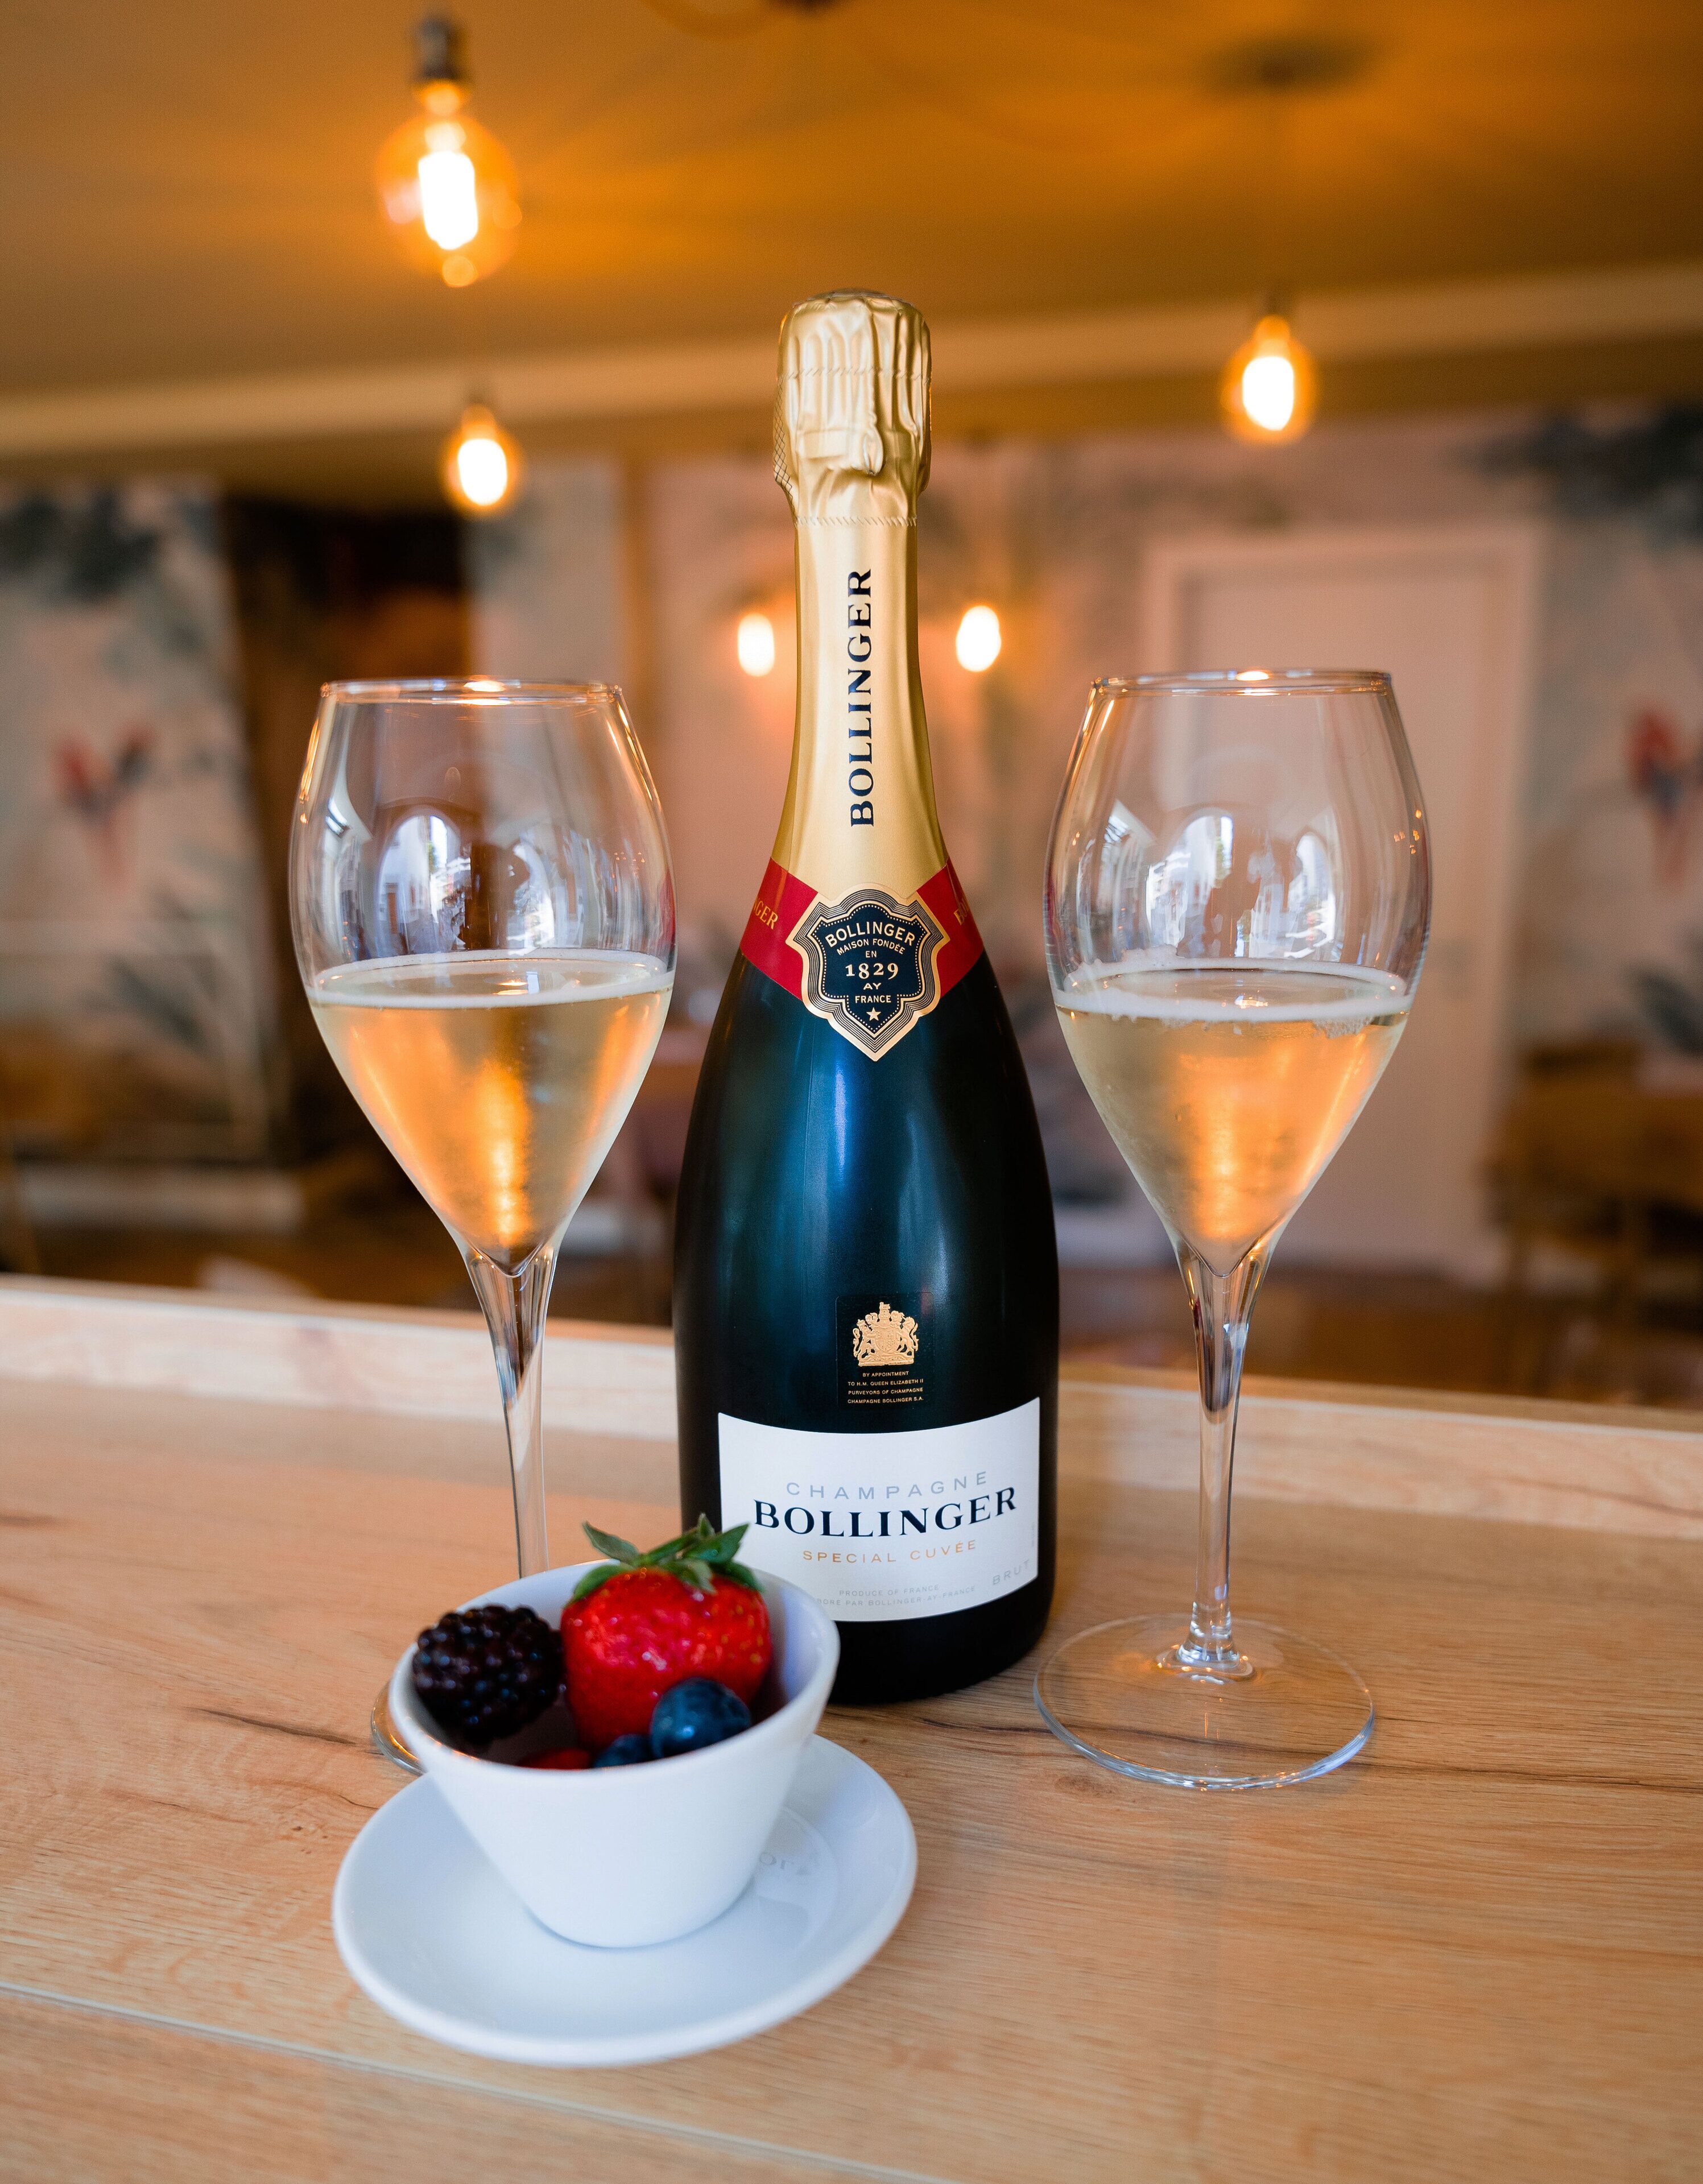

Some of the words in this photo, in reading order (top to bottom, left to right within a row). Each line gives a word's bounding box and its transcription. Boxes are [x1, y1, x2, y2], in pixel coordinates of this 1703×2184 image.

[848, 569, 874, 827] BOLLINGER
[825, 921, 915, 948] BOLLINGER
[837, 938, 869, 956] MAISON
[873, 938, 905, 954] FONDÉE
[845, 963, 899, 980] 1829
[786, 1471, 987, 1500] CHAMPAGNE
[753, 1487, 1017, 1537] BOLLINGER
[803, 1550, 896, 1563] SPECIAL
[910, 1539, 976, 1560] CUVÉE
[993, 1559, 1029, 1585] BRUT
[904, 1584, 939, 1594] FRANCE
